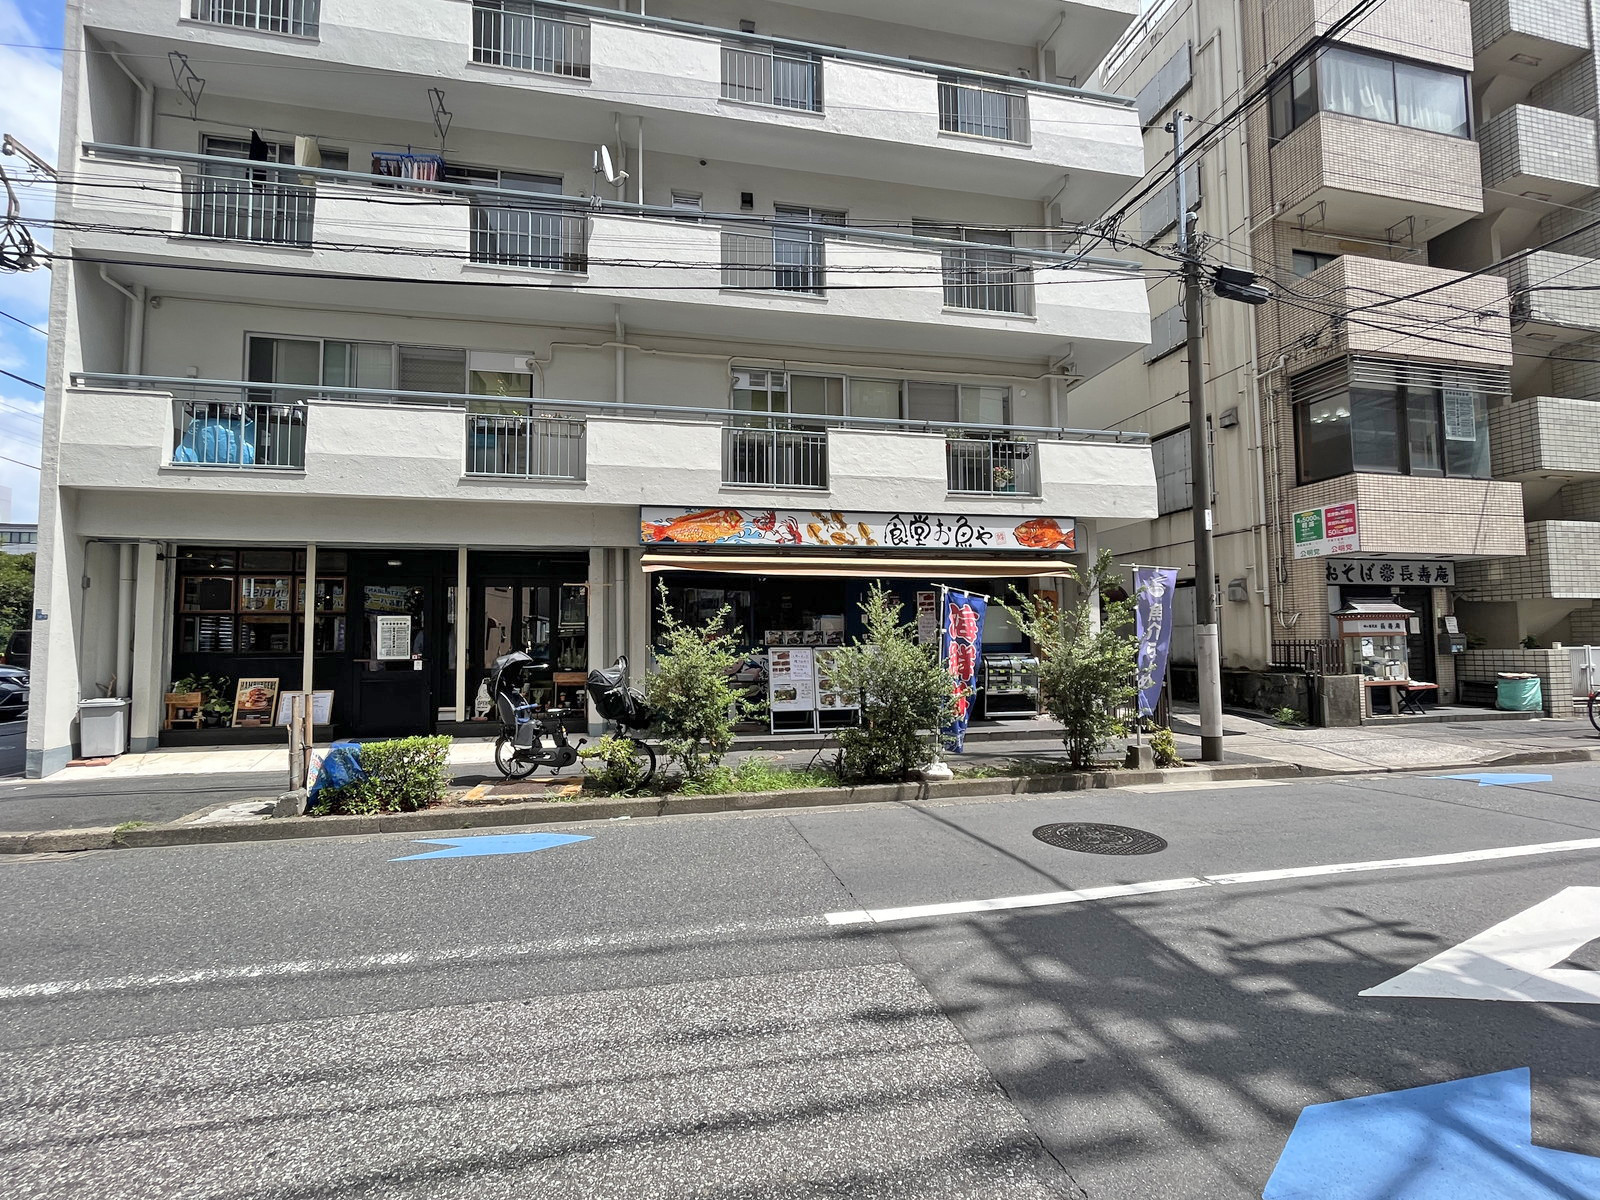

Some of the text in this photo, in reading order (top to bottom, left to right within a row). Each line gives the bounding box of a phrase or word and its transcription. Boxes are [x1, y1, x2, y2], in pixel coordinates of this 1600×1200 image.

[884, 513, 993, 548] 食堂お魚や
[1300, 548, 1320, 557] 公明党
[1331, 543, 1353, 553] 公明党
[1325, 562, 1375, 583] おそば
